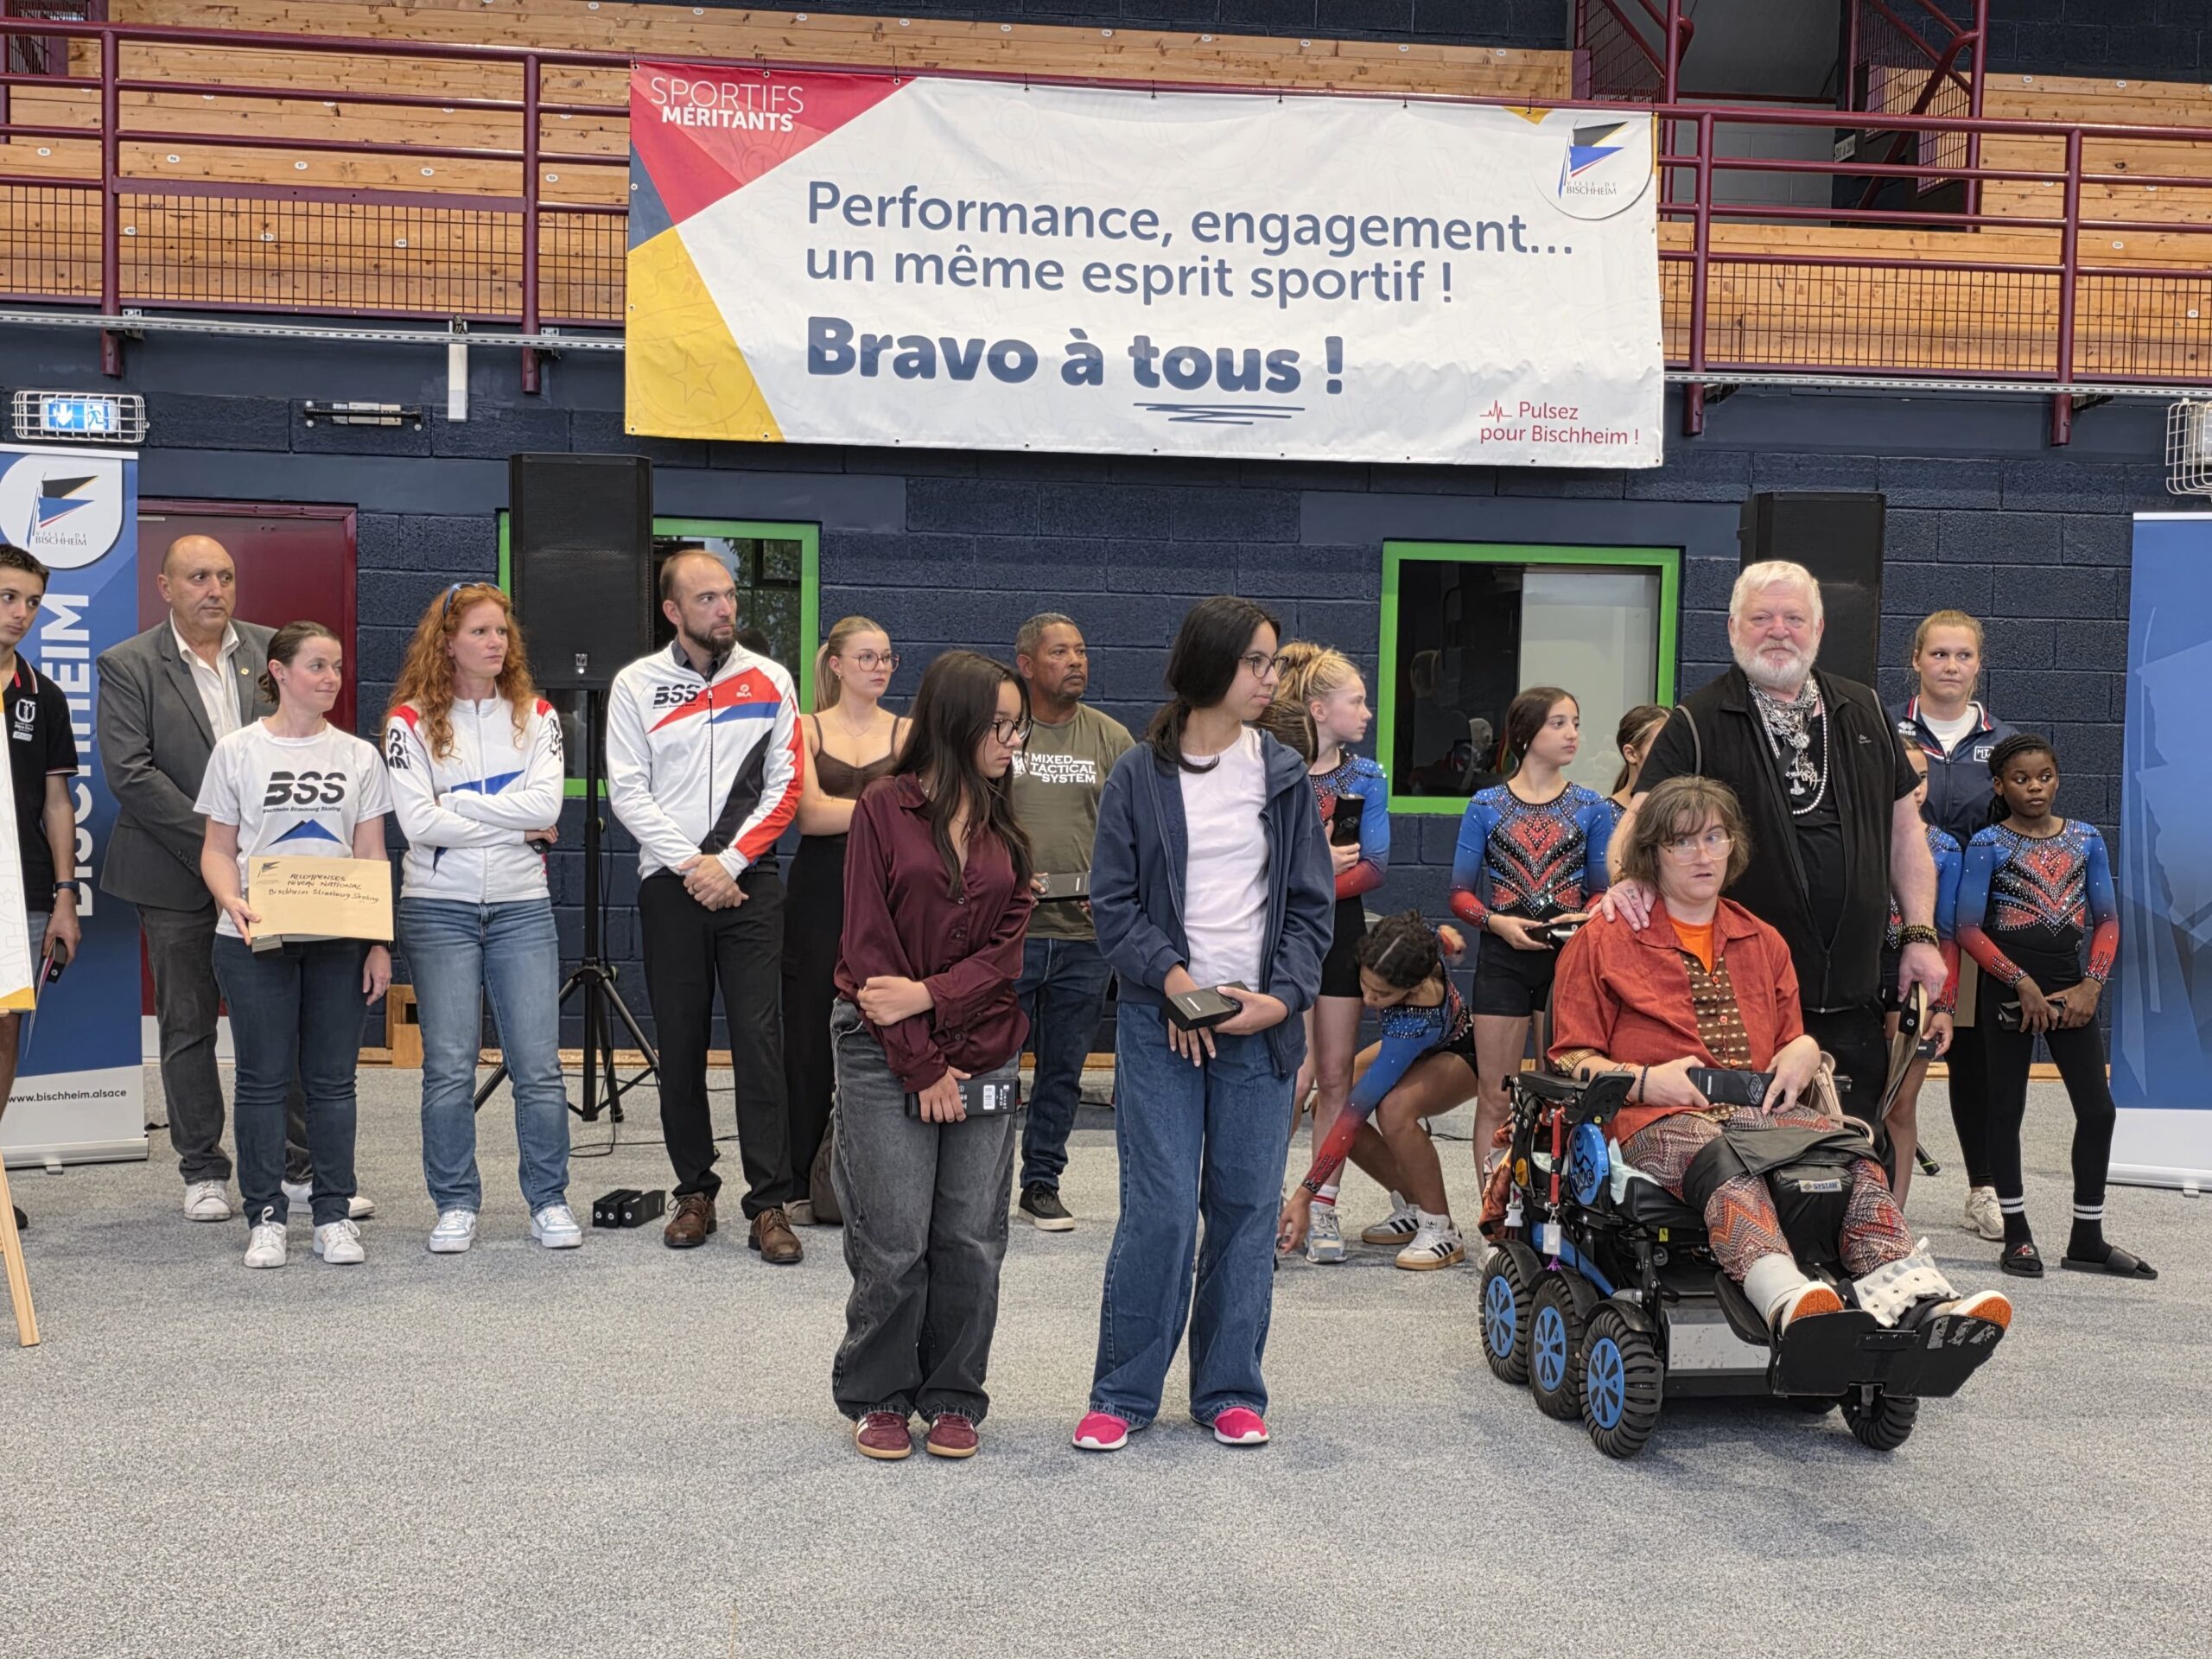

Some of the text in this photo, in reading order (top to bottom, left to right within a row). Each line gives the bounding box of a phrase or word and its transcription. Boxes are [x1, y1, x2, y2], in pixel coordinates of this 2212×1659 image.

[651, 76, 804, 114] SPORTIFS
[661, 101, 793, 132] MÉRITANTS
[1567, 186, 1618, 196] BISCHHEIM
[807, 181, 1573, 257] Performance, engagement...
[806, 245, 1452, 309] un même esprit sportif !
[807, 316, 1343, 395] Bravo à tous !
[1519, 401, 1579, 421] Pulsez
[1480, 426, 1639, 445] pour Bischheim !
[35, 536, 87, 546] BISCHHEIM
[653, 683, 701, 706] BSS
[1030, 762, 1096, 775] TACTICAL
[1031, 753, 1073, 765] MIXED
[1041, 773, 1096, 785] SYSTEM
[263, 771, 347, 808] BSS
[8, 1089, 128, 1103] www.bischheim.alsace
